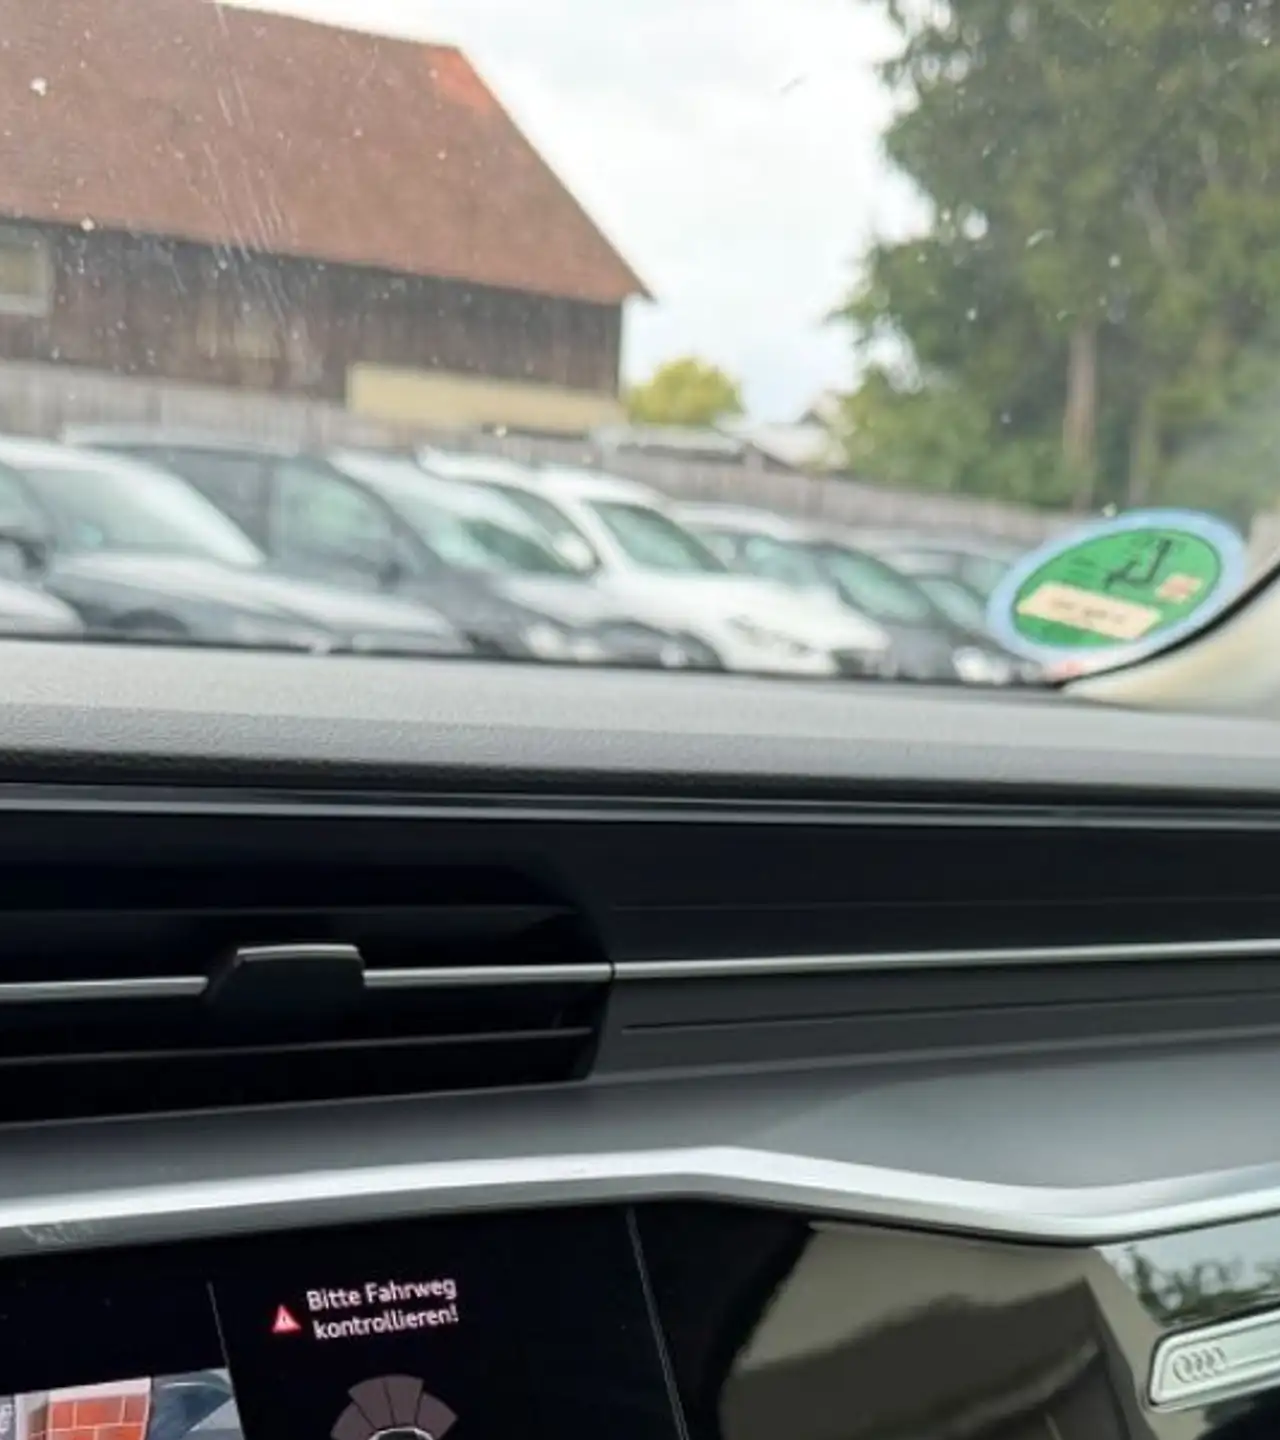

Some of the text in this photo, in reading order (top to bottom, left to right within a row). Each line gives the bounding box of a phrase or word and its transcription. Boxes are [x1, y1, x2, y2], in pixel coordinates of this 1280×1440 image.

[306, 1278, 457, 1312] Bitte Fahrweg
[312, 1302, 459, 1340] kontrollieren!
